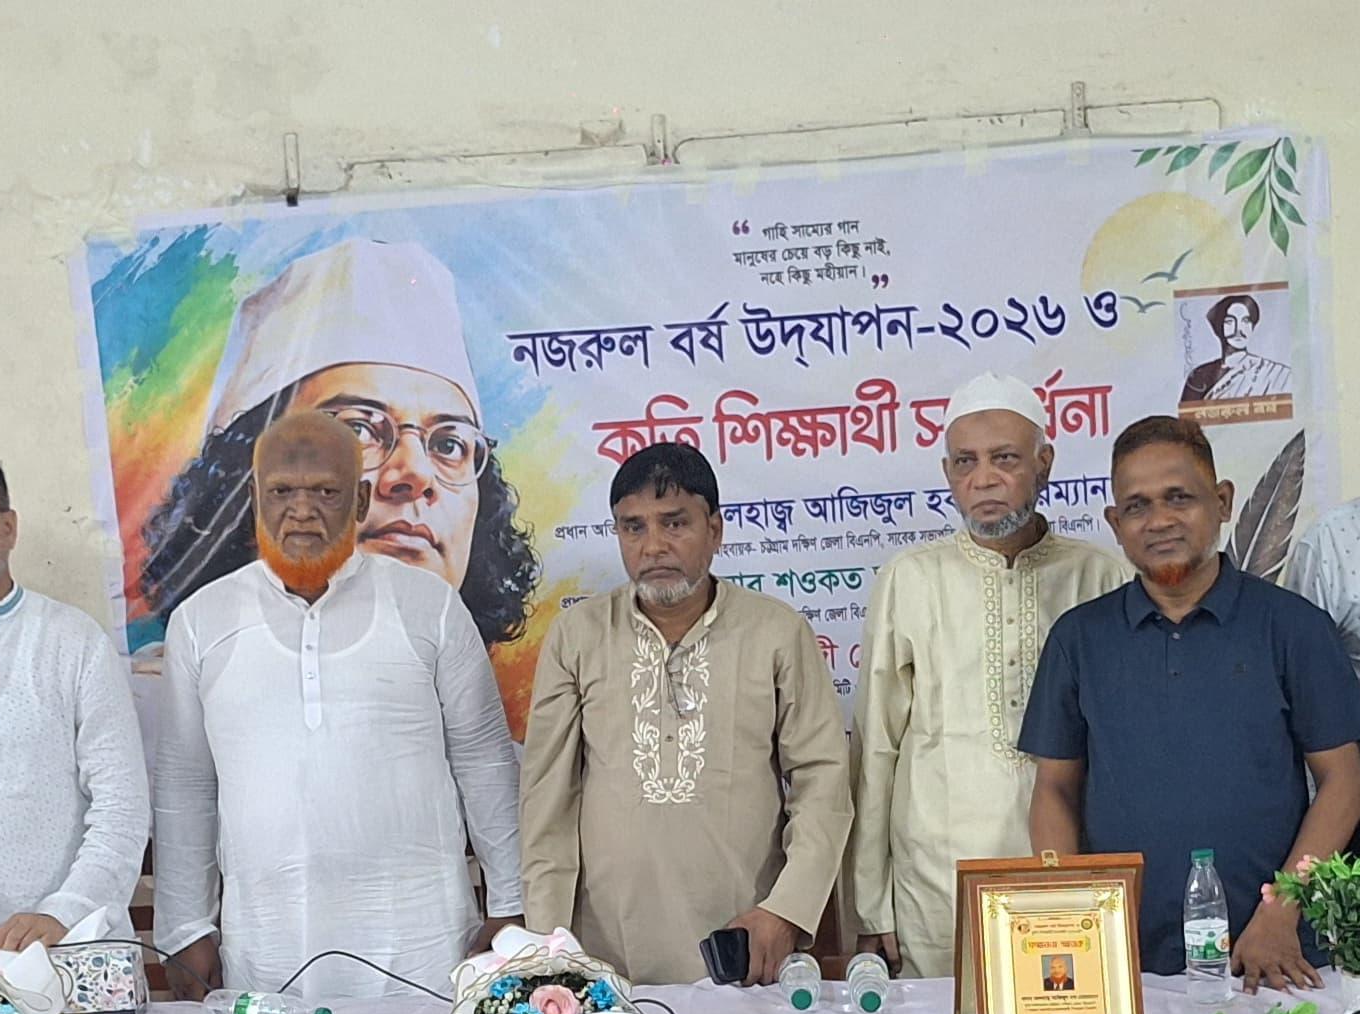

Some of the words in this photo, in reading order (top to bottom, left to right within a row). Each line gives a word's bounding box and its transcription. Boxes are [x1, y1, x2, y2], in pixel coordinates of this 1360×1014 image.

[762, 223, 789, 241] গাহি
[791, 222, 833, 239] সাম্যের
[732, 249, 777, 268] মানুষের
[781, 246, 809, 262] চেয়ে
[813, 244, 833, 261] বড়
[836, 240, 862, 260] কিছু
[759, 271, 785, 286] নহে
[788, 266, 812, 286] কিছু
[507, 324, 655, 377] নজরুল
[664, 301, 731, 366] বর্ষ
[1084, 290, 1119, 329] ও
[555, 524, 591, 541] প্রধান
[720, 498, 796, 534] লহাজ্ব
[802, 486, 916, 526] আজিজুল
[771, 567, 866, 598] শওকত
